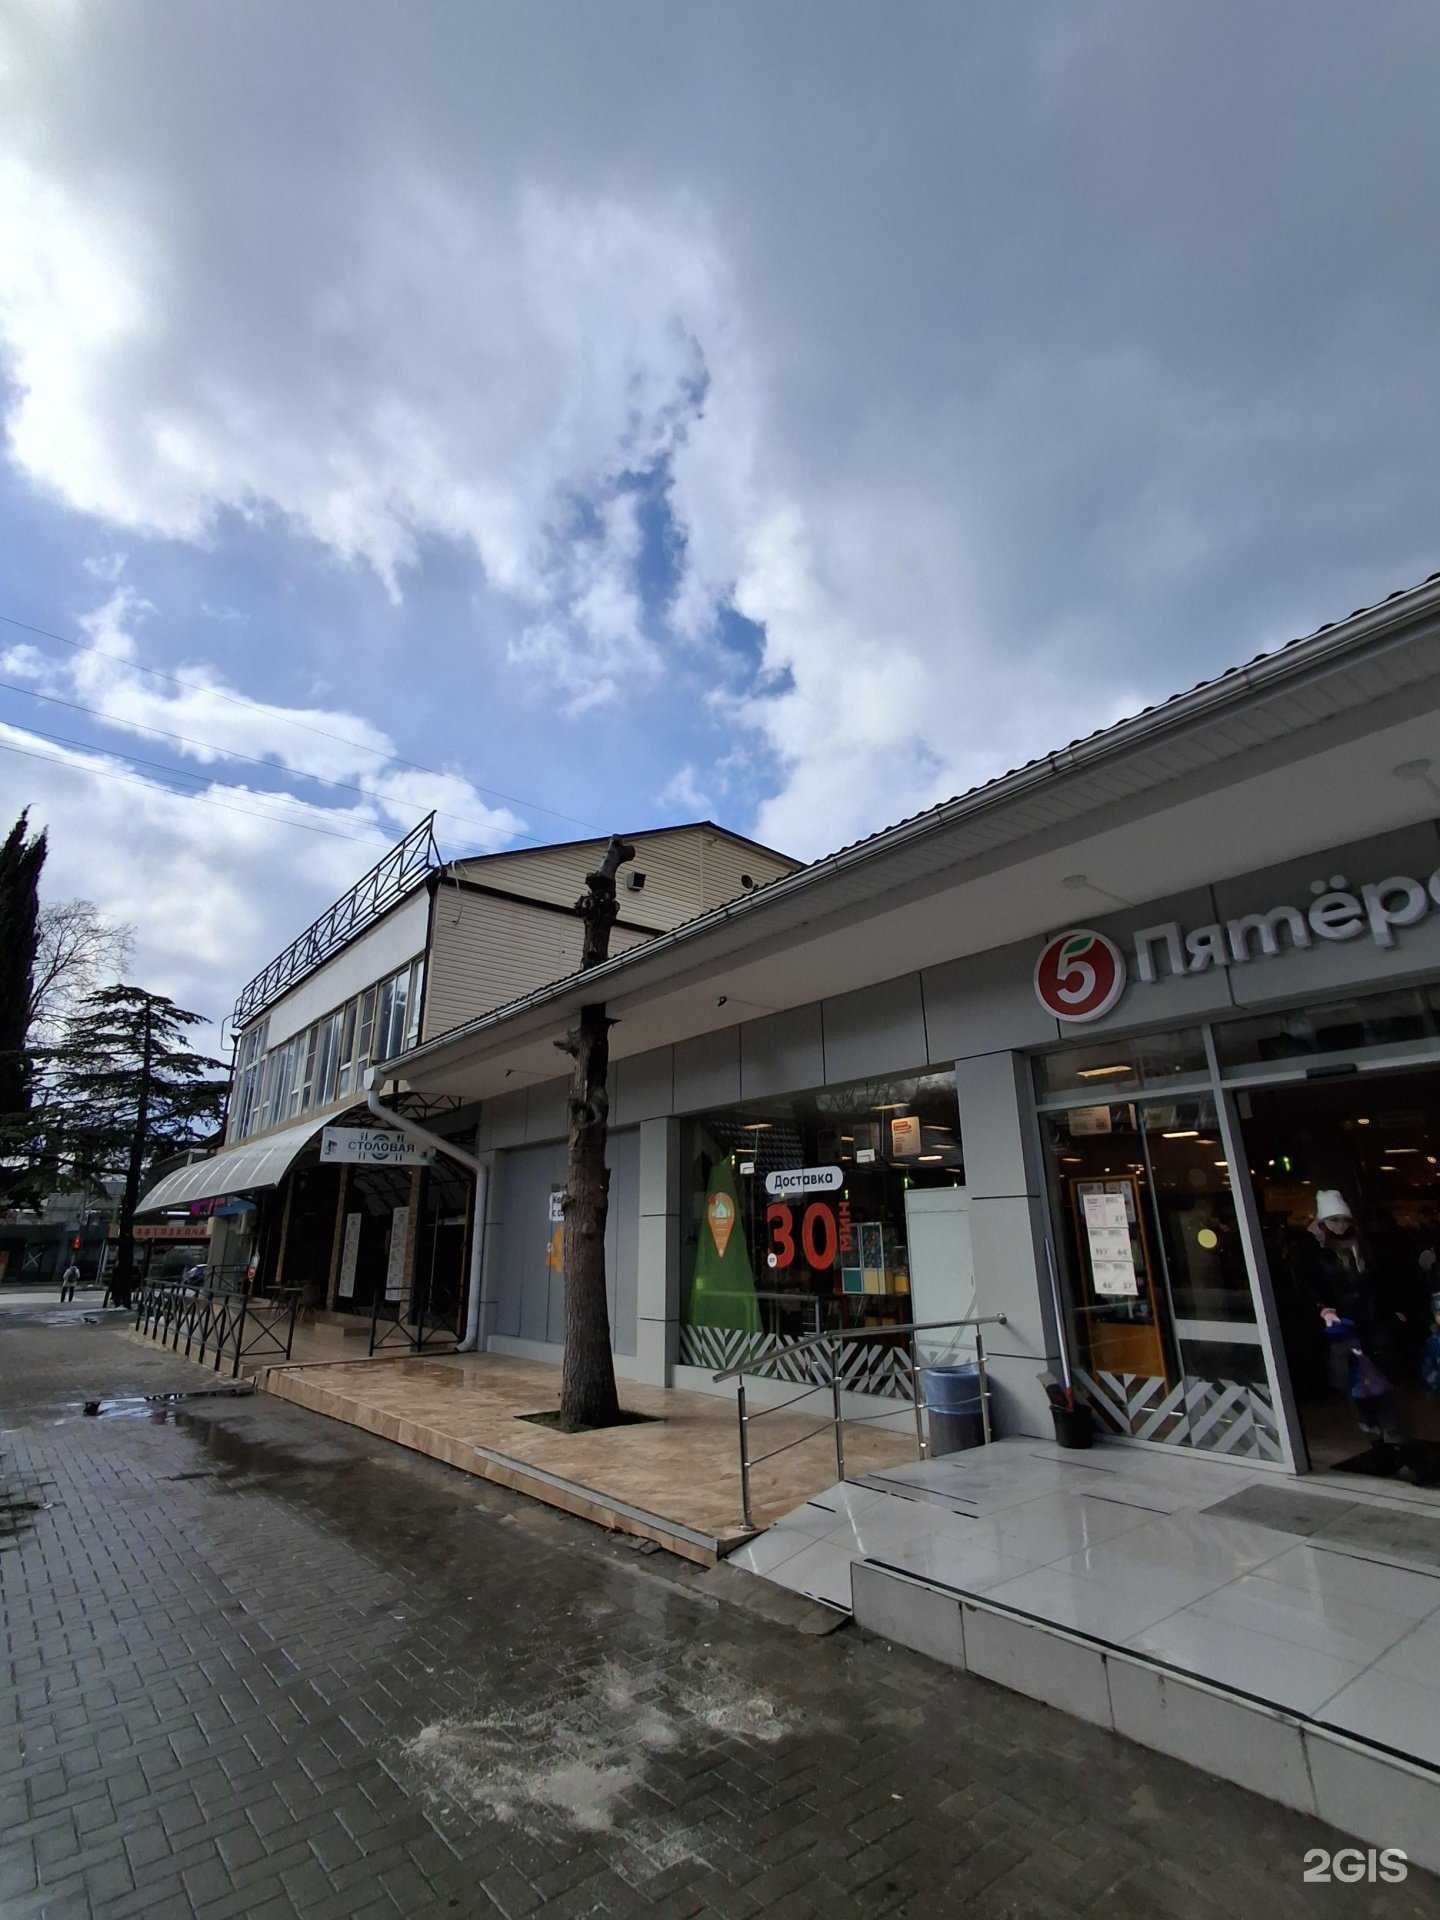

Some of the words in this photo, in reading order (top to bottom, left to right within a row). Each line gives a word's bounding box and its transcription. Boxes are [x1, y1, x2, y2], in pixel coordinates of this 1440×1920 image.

[1133, 868, 1440, 982] Пятёр
[1057, 936, 1096, 1004] 5
[348, 1140, 415, 1153] СТОЛОВАЯ
[774, 1173, 833, 1190] Доставка
[767, 1202, 837, 1271] 30
